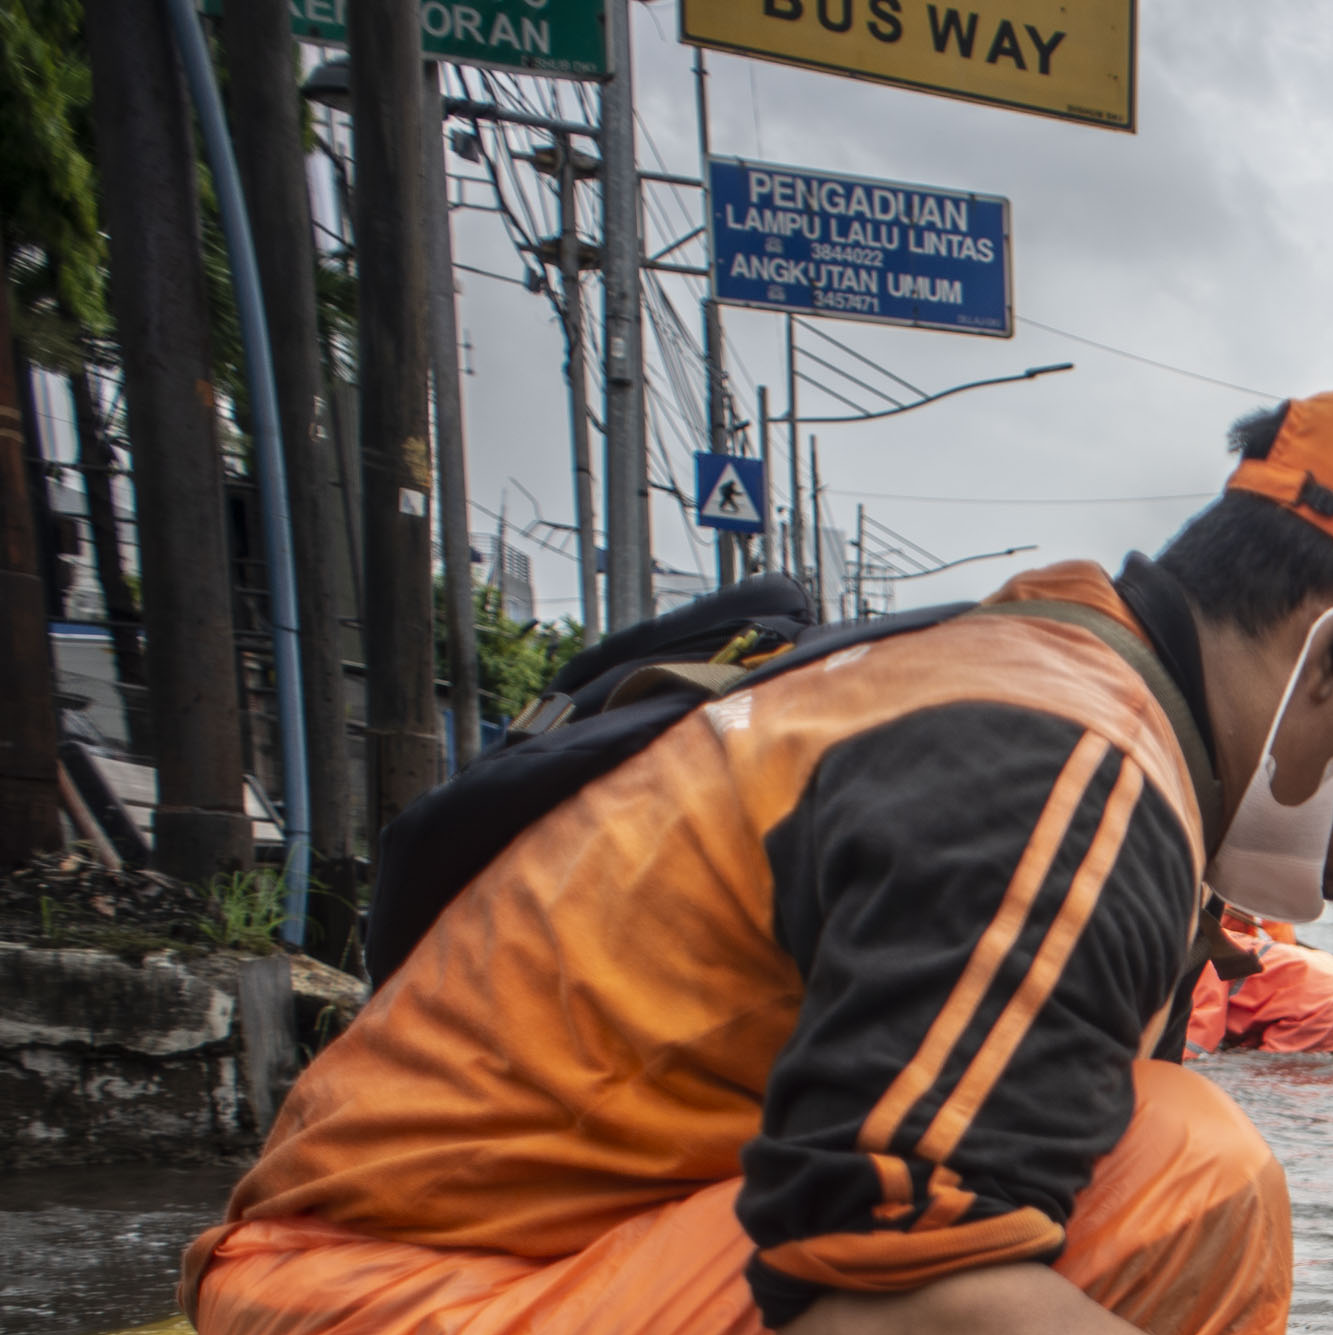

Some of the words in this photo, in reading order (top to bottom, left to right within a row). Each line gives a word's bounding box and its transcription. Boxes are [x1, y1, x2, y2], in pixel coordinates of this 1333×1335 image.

[926, 3, 1067, 76] WAY
[749, 171, 969, 232] PENGADUAN
[726, 203, 821, 240] LAMPU
[830, 218, 899, 249] LALU
[909, 229, 994, 263] LINTAS
[811, 242, 884, 268] 3844022
[730, 253, 879, 295] ANGKUTAN
[887, 273, 963, 304] UMUM
